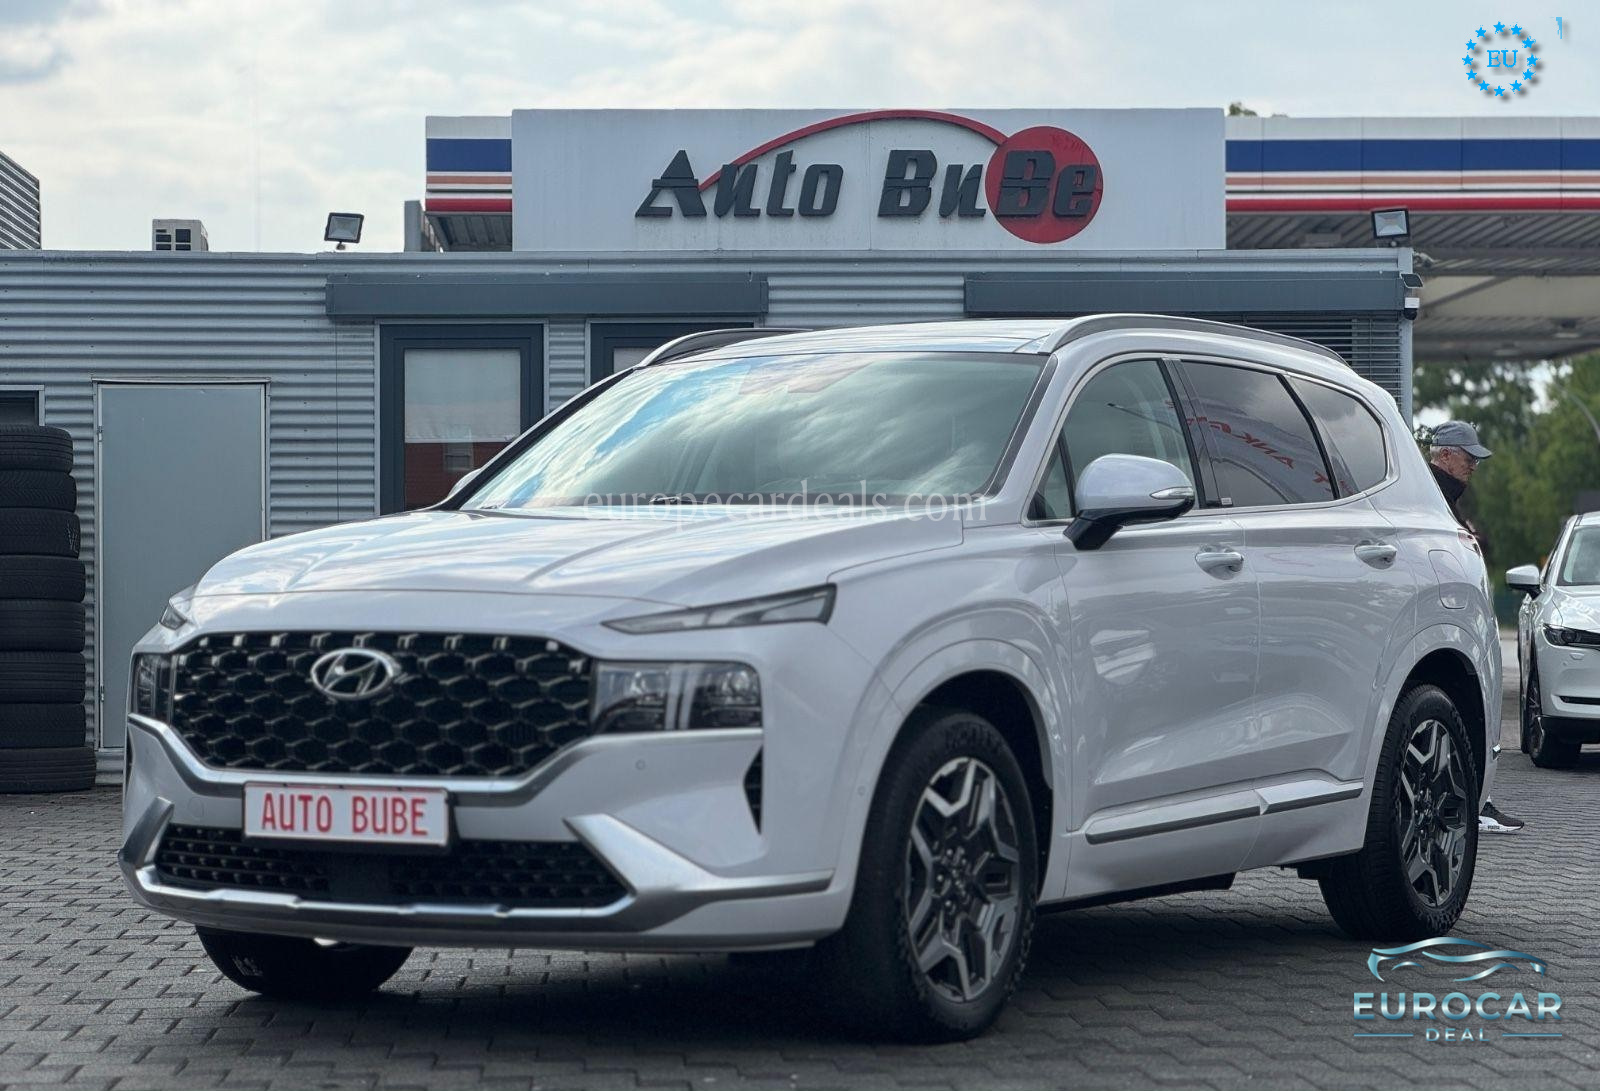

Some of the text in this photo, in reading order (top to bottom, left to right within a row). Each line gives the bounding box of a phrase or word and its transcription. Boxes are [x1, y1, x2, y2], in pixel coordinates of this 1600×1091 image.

[634, 150, 844, 218] Auto
[261, 792, 428, 836] AUTO BUBE
